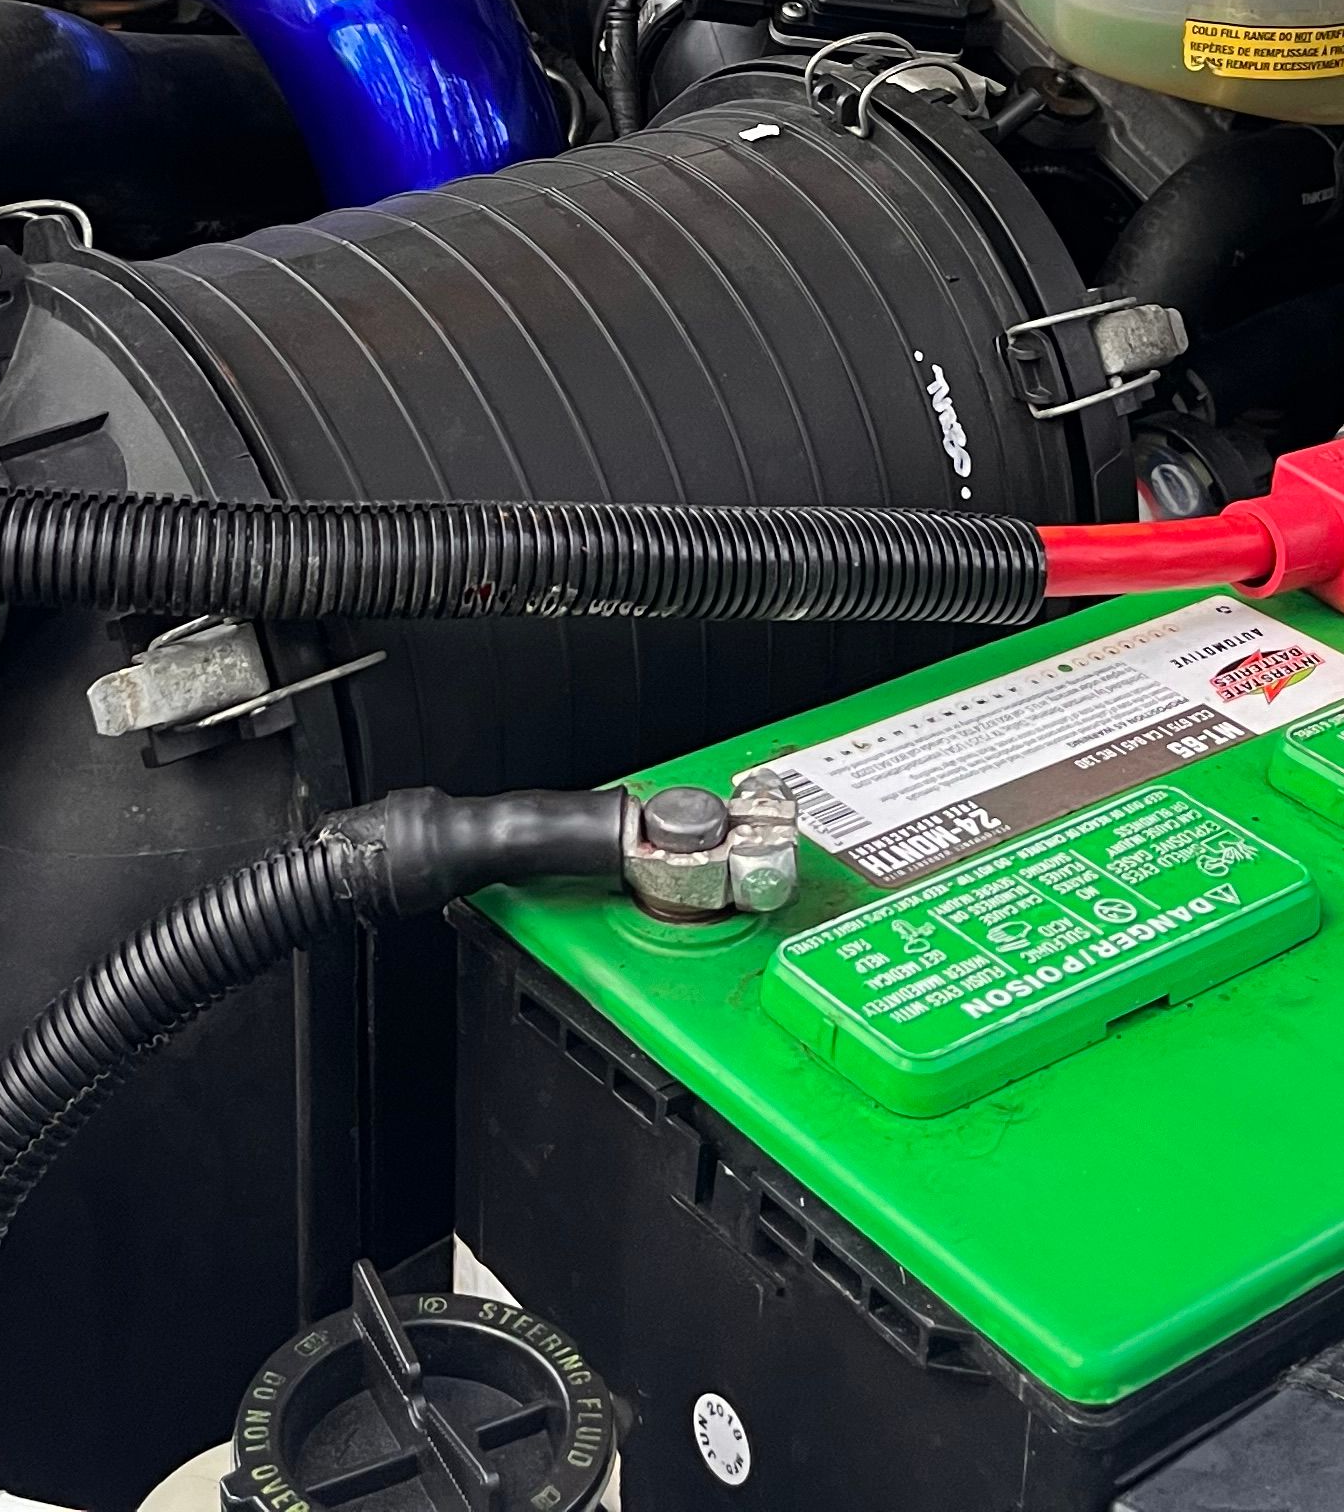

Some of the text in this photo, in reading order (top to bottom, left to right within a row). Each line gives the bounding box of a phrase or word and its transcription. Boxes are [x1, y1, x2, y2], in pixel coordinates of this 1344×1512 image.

[1190, 41, 1234, 55] REPÈRES
[1237, 45, 1251, 57] DE
[1254, 46, 1318, 57] REMPLISSAGE
[1192, 25, 1217, 37] COLD
[1220, 28, 1240, 40] FILL
[1243, 31, 1275, 41] RANGE
[1279, 32, 1292, 41] DO
[1295, 32, 1311, 42] NOT
[1205, 58, 1223, 68] PAS
[1226, 59, 1270, 71] REMPLIR
[1273, 58, 1344, 71] EXCESSIVEMENT
[1169, 628, 1264, 668] AUTOMOTIVE
[1212, 647, 1303, 687] BATTERIES
[1220, 653, 1324, 700] INTERSTATE
[1165, 717, 1194, 733] 675
[1186, 708, 1215, 724] CCA
[1094, 747, 1116, 760] RC
[1140, 728, 1164, 742] CA
[1164, 719, 1246, 760] MT-65
[1072, 754, 1101, 769] 130
[939, 800, 980, 819] FREE
[1110, 800, 1190, 837] OR BLINDNESS
[841, 815, 947, 859] REPLACEMENT
[849, 808, 1006, 876] 24-MONTH
[1101, 809, 1204, 857] CAN CAUSE INJURY
[1104, 819, 1222, 874] EXPLOSIVE GASES
[1017, 851, 1072, 878] SMOKING
[1037, 861, 1086, 885] FLAMES
[1051, 870, 1099, 893] SPARKS
[1119, 842, 1207, 884] SHIELD EYES
[930, 875, 1016, 916] SEVERE INJURY
[947, 884, 1029, 923] BLINDNESS OR
[977, 893, 1043, 925] CAN CAUSE
[1072, 884, 1101, 900] NO
[1017, 926, 1092, 963] SULFURIC
[1035, 916, 1075, 937] ACID
[832, 937, 873, 959] FAST
[848, 950, 891, 974] HELP
[958, 895, 1217, 1019] DANGER/POISON
[856, 953, 991, 1017] WATER IMMEDIATELY
[862, 949, 949, 991] GET MEDICAL
[887, 964, 1007, 1023] FLUSH EYES WITH
[253, 1370, 287, 1400] DO
[479, 1302, 603, 1467] STEERING FLUID
[244, 1408, 272, 1452] NOT
[698, 1414, 716, 1459] JUN
